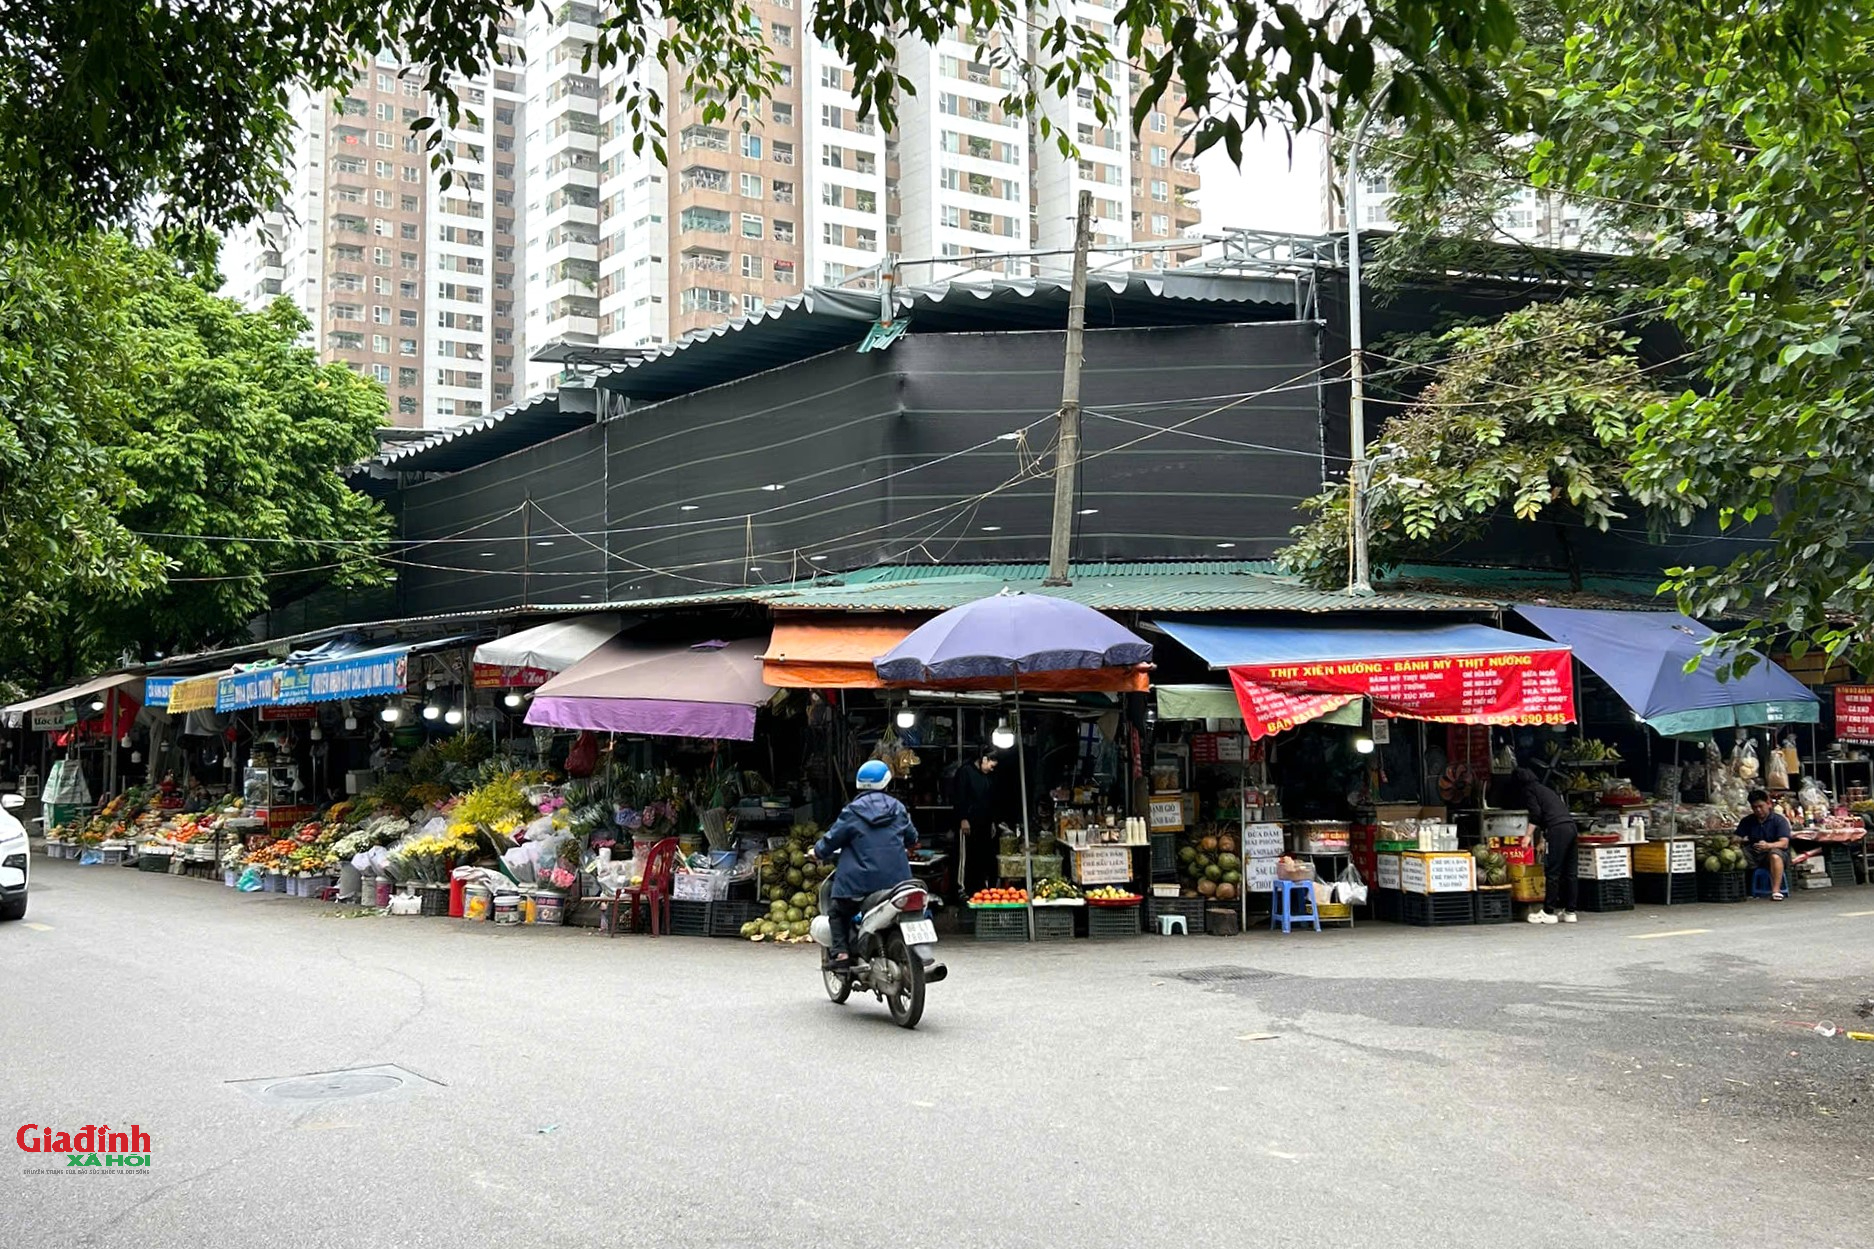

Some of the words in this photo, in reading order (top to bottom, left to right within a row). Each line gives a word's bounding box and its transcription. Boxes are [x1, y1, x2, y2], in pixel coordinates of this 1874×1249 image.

[1269, 667, 1299, 679] THỊT
[1303, 664, 1334, 677] XIÊN
[1338, 661, 1382, 674] NƯỚNG
[1394, 659, 1429, 671] BÁNH
[1457, 658, 1485, 669] THỊT
[1489, 655, 1532, 666] NƯỚNG
[1521, 714, 1542, 723] 690
[1545, 713, 1565, 722] 845
